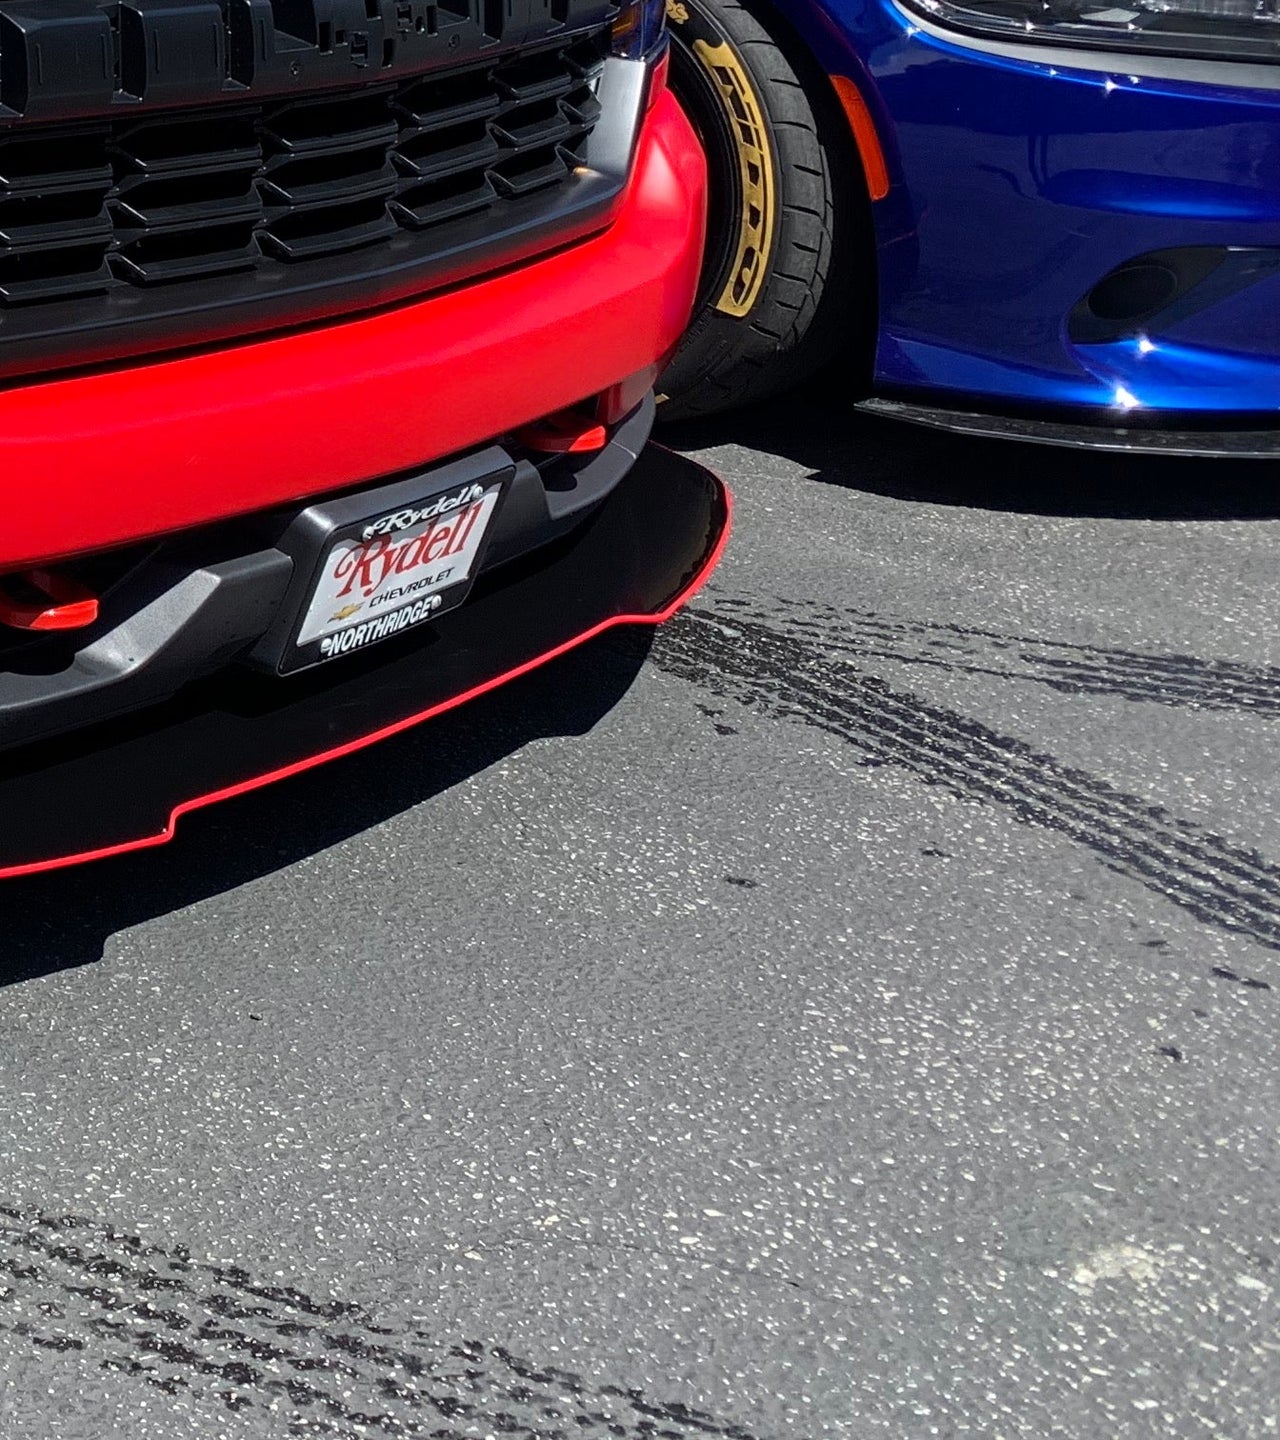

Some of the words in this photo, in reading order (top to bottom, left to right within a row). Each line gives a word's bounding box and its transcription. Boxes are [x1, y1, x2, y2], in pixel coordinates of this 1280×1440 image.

[372, 482, 480, 534] Rydell
[334, 497, 486, 598] Rydell
[369, 567, 455, 608] CHEVROLET
[327, 600, 433, 656] NORTHRIDGE
